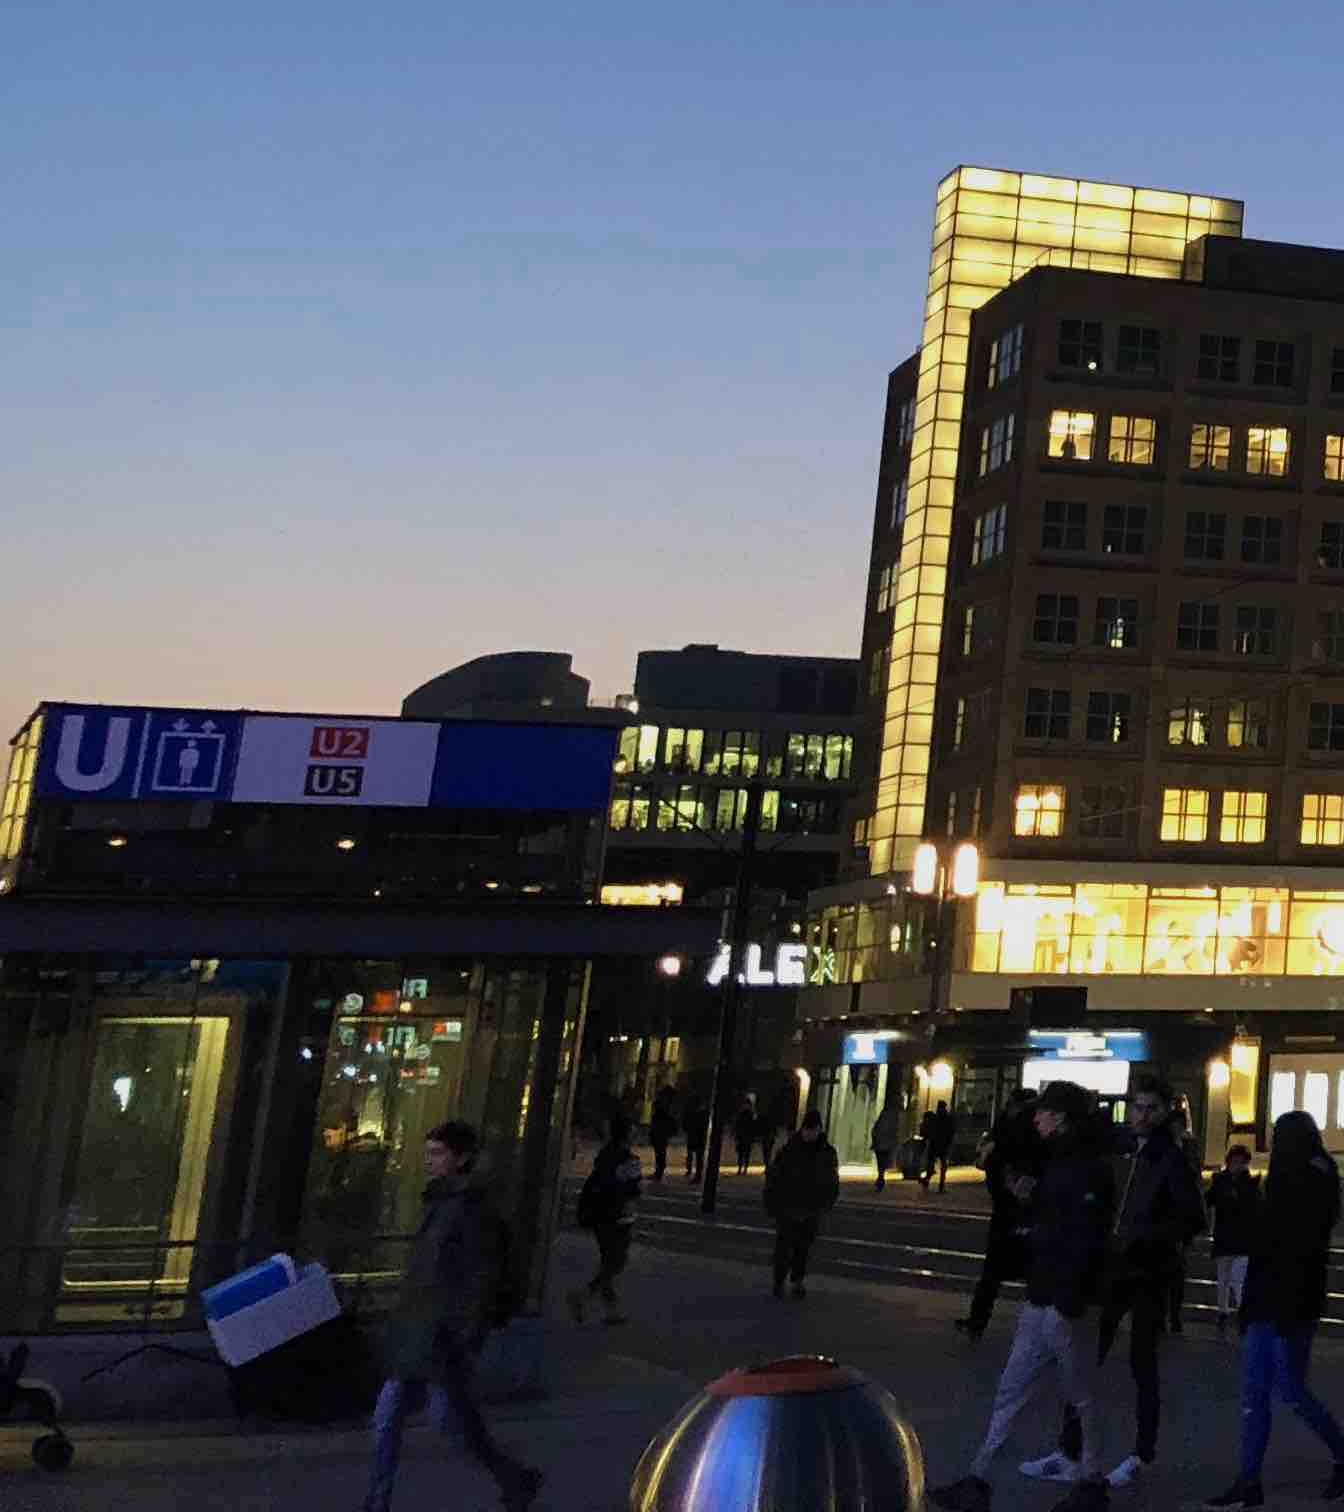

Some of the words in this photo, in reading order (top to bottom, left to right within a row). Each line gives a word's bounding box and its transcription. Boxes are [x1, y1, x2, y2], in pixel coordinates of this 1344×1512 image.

[55, 713, 132, 792] U
[316, 730, 364, 756] U2
[311, 768, 357, 794] U5
